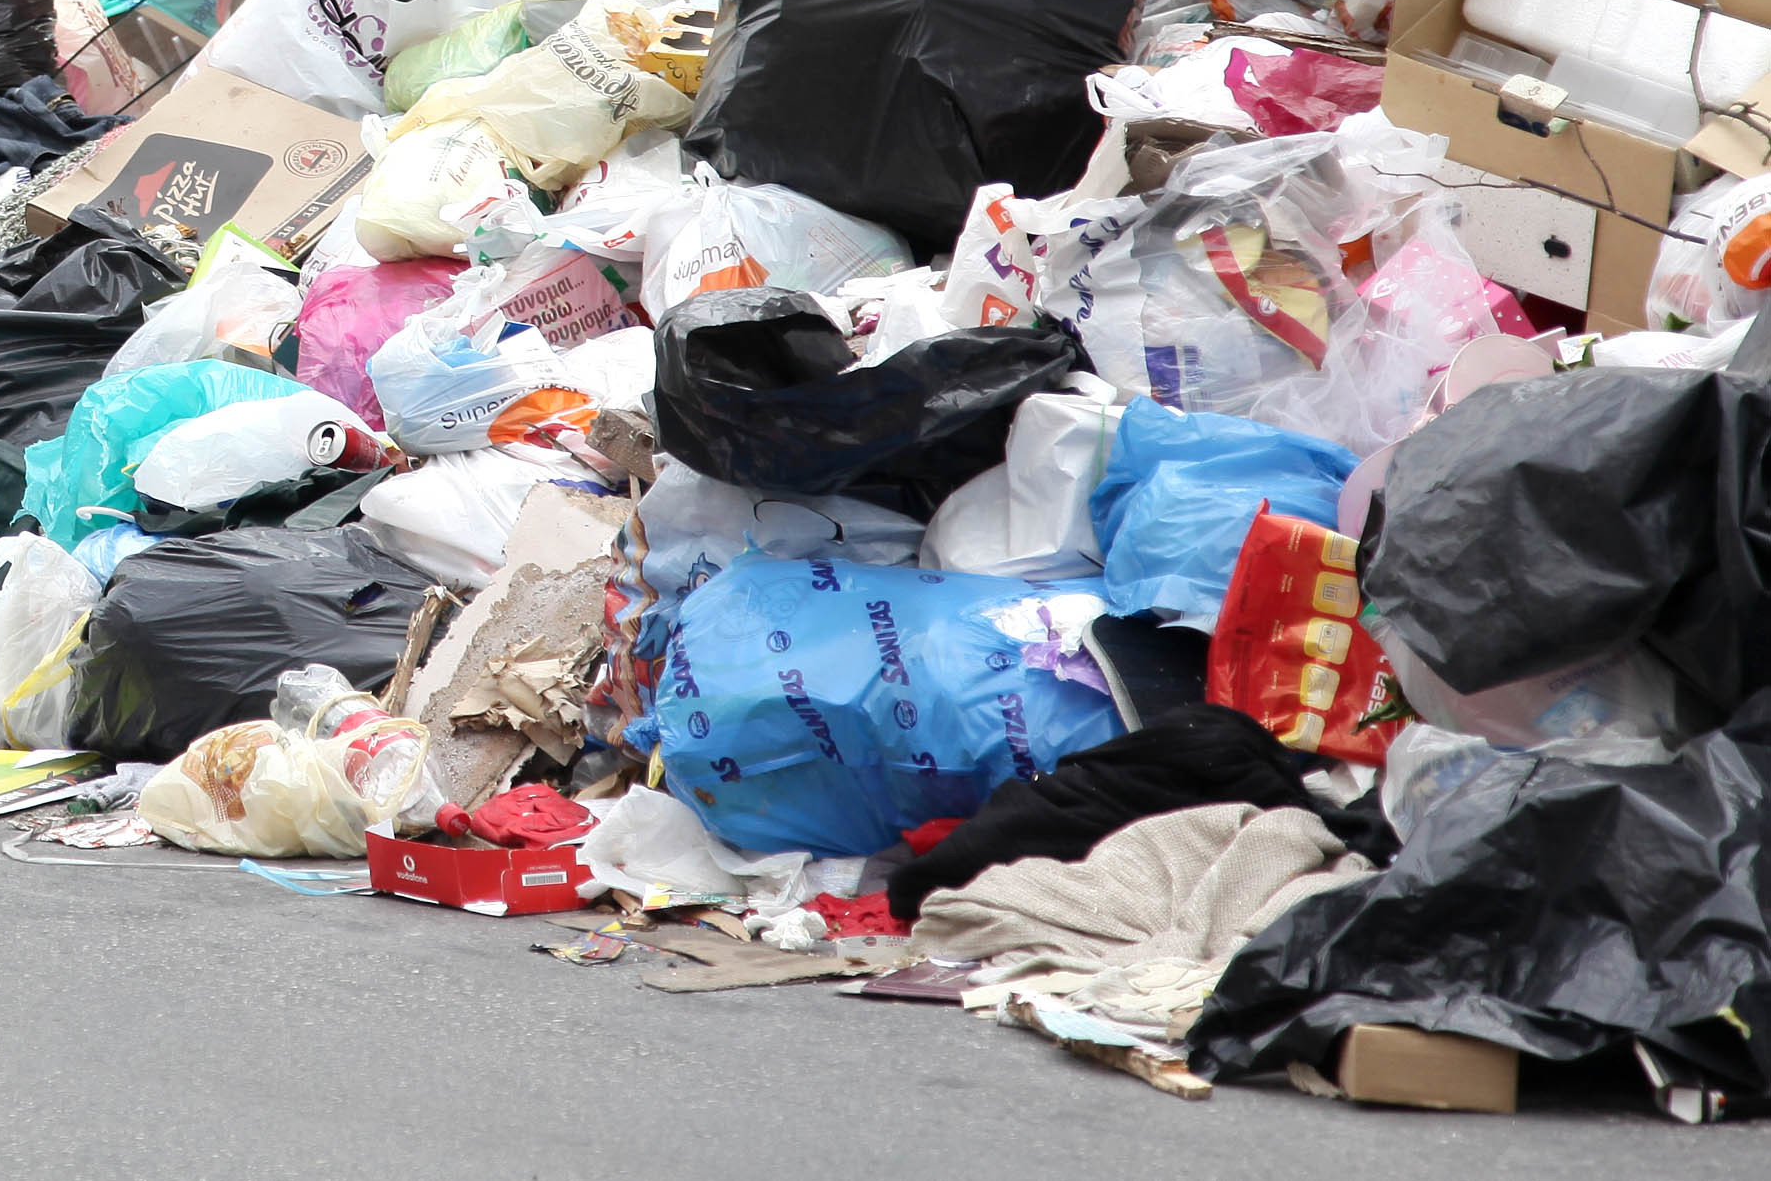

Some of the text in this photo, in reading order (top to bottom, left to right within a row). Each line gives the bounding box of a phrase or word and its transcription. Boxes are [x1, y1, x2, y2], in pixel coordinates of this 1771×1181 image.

[866, 600, 910, 687] SANITAS
[778, 669, 844, 765] SANITAS
[396, 871, 429, 884] vodafone
